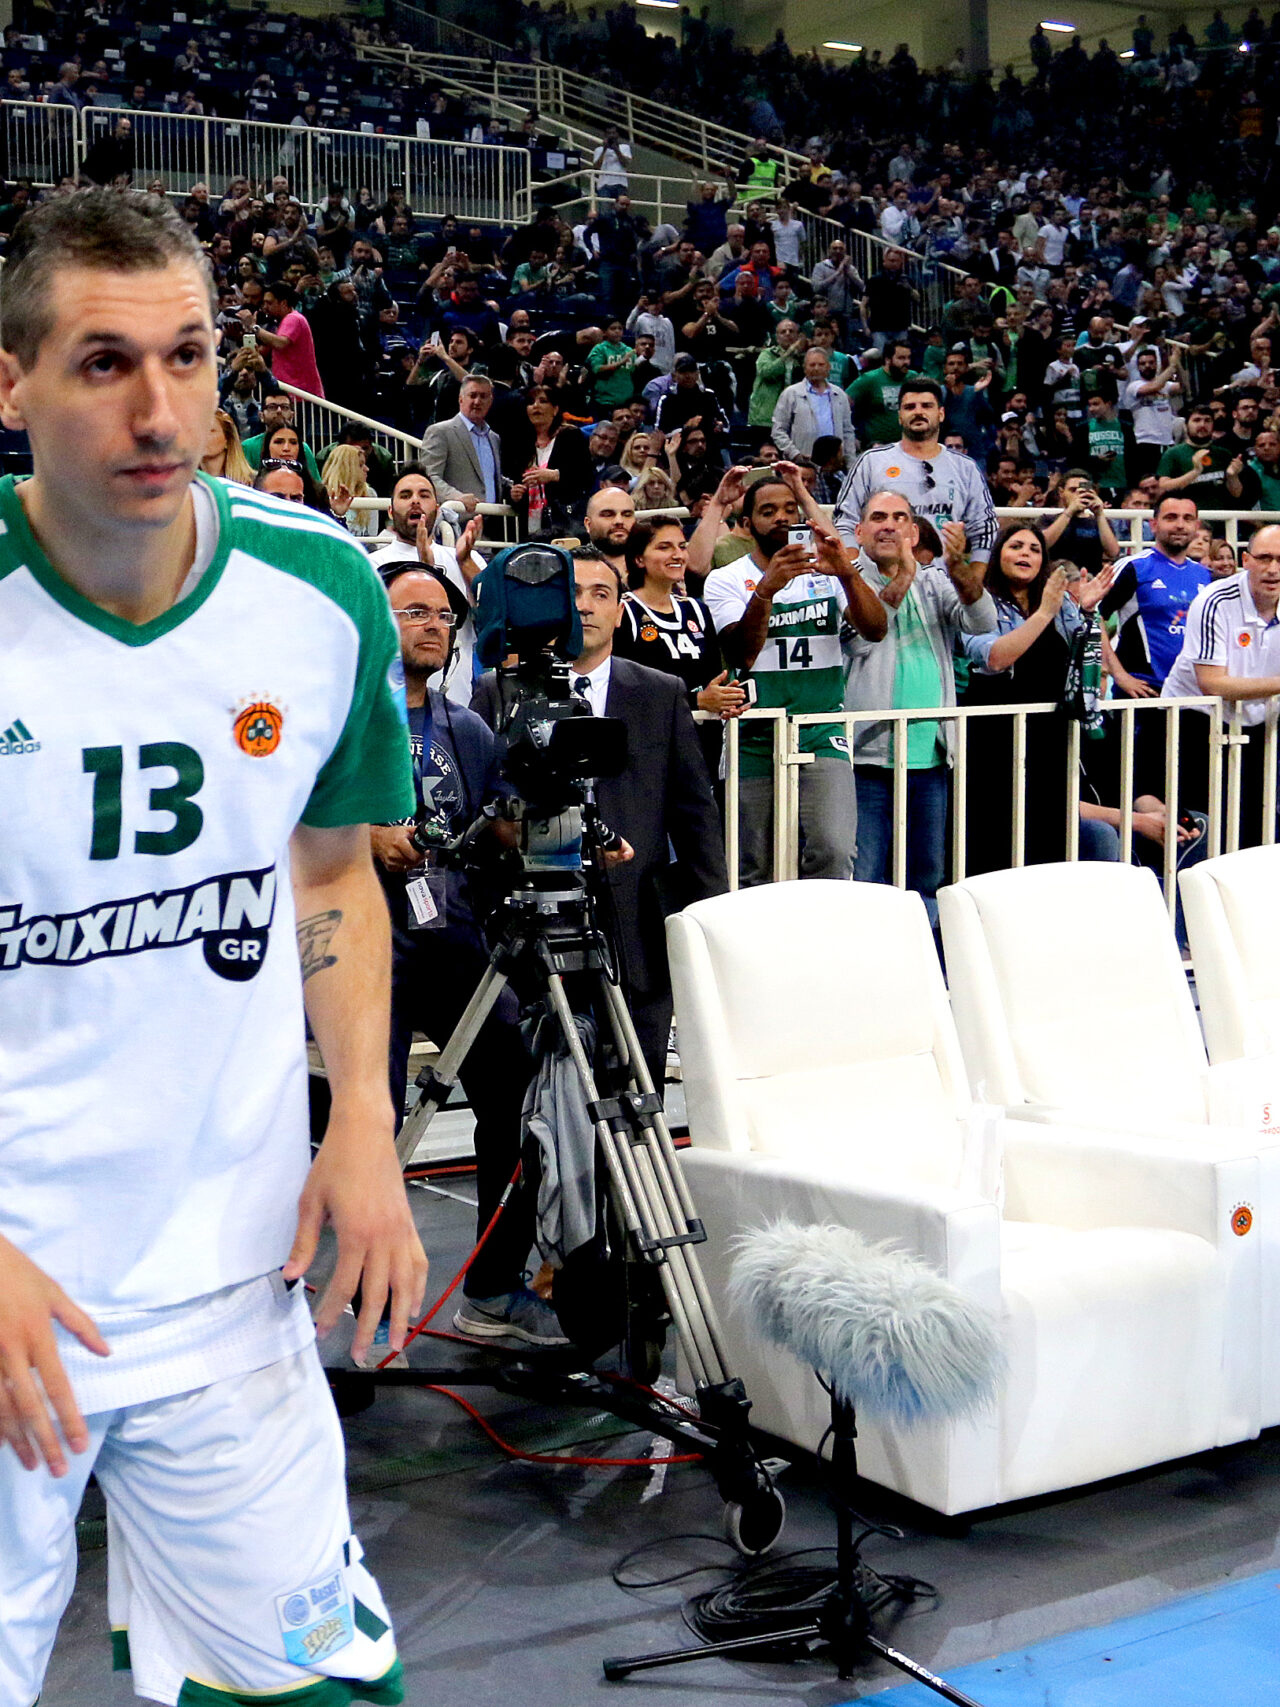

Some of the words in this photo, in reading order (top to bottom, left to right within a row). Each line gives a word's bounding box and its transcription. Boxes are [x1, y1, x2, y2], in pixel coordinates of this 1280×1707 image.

[658, 632, 701, 659] 14
[775, 638, 813, 670] 14
[81, 741, 206, 861] 13
[218, 937, 261, 962] GR
